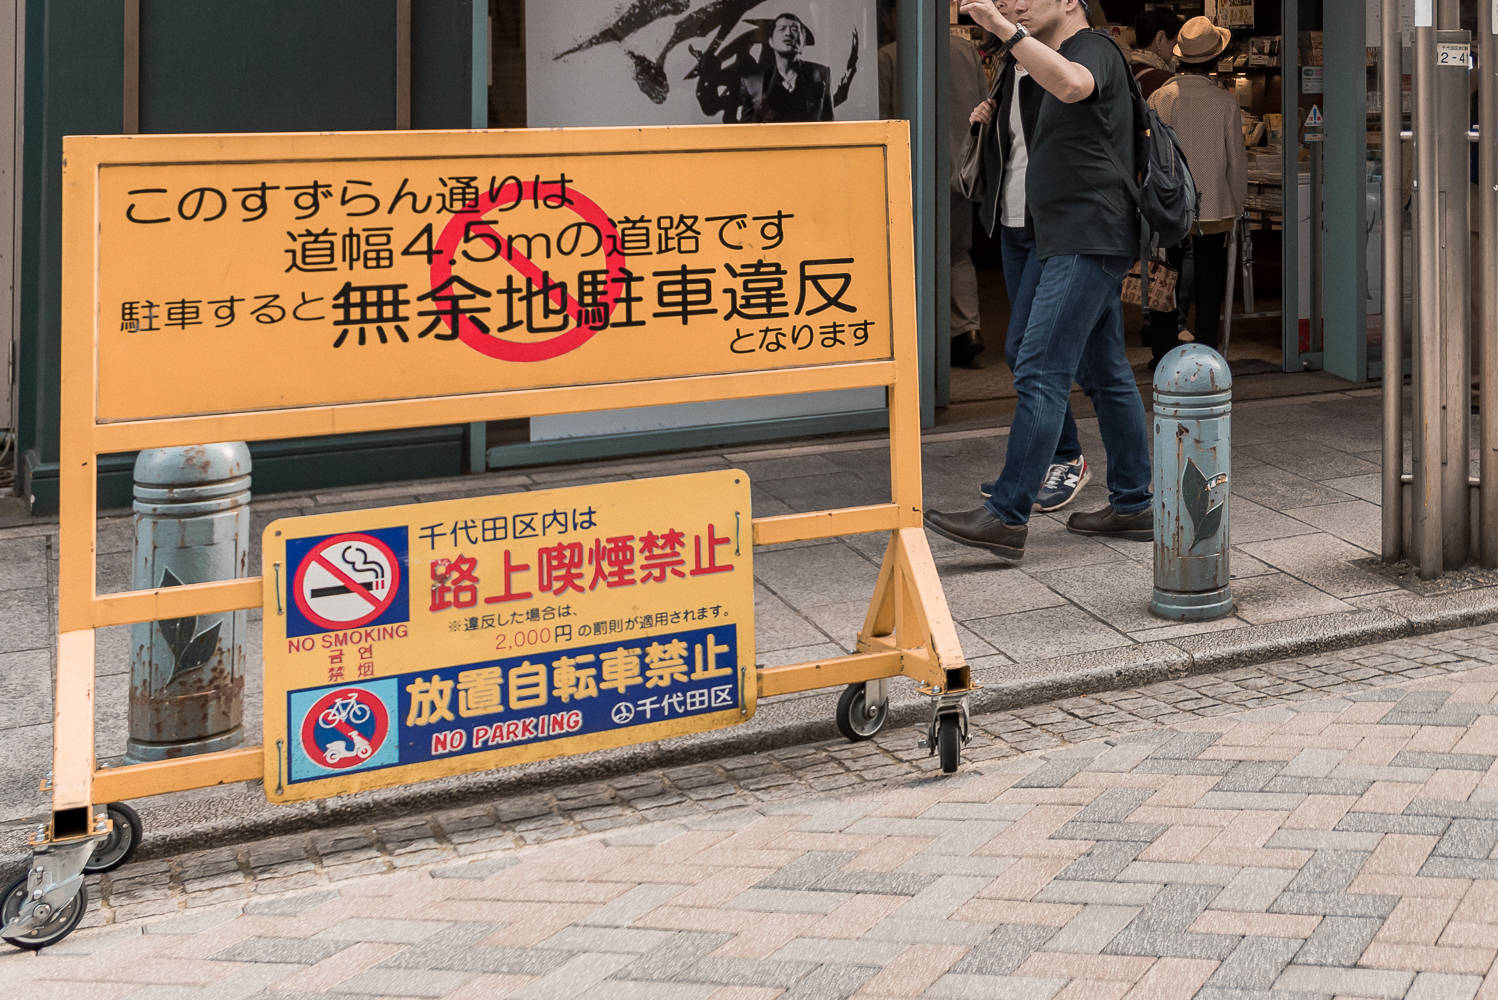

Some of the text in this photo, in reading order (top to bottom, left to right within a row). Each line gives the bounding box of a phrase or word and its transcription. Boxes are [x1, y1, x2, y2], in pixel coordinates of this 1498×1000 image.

[126, 173, 575, 224] このすずらん通りは
[284, 210, 795, 273] 道幅4.5mの道路です
[729, 319, 876, 354] となります
[418, 506, 598, 550] 千代田区内は
[429, 523, 735, 613] 路上喫煙禁止
[288, 624, 409, 654] NO SMOKING
[405, 633, 733, 728] 放置自転車禁止
[636, 684, 734, 719] 千代田区
[431, 709, 584, 755] NO PARKING
